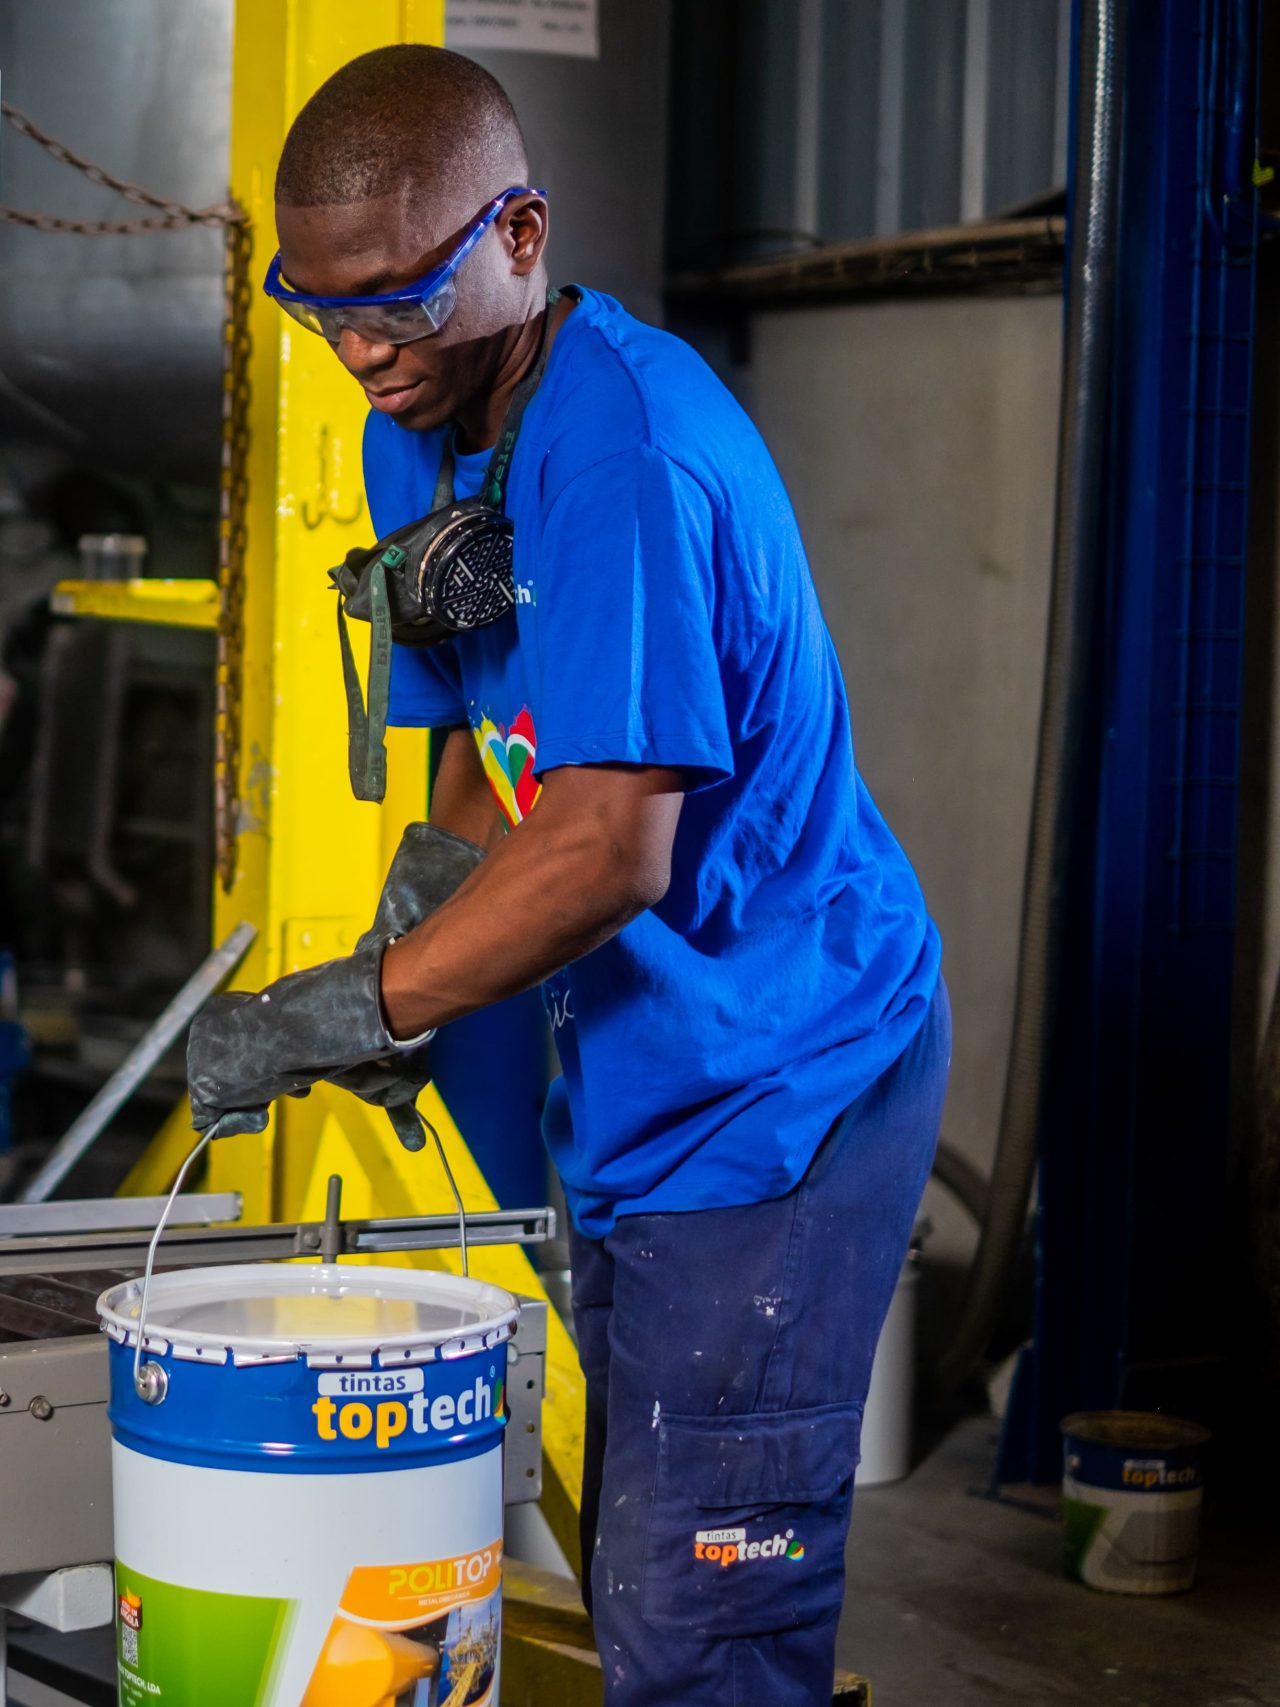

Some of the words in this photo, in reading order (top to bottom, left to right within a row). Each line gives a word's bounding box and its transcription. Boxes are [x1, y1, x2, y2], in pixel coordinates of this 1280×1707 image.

[339, 1374, 406, 1392] tintas
[311, 1376, 491, 1449] toptech
[694, 1534, 788, 1567] toptech
[706, 1530, 737, 1542] tintas
[388, 1551, 492, 1596] POLITOP
